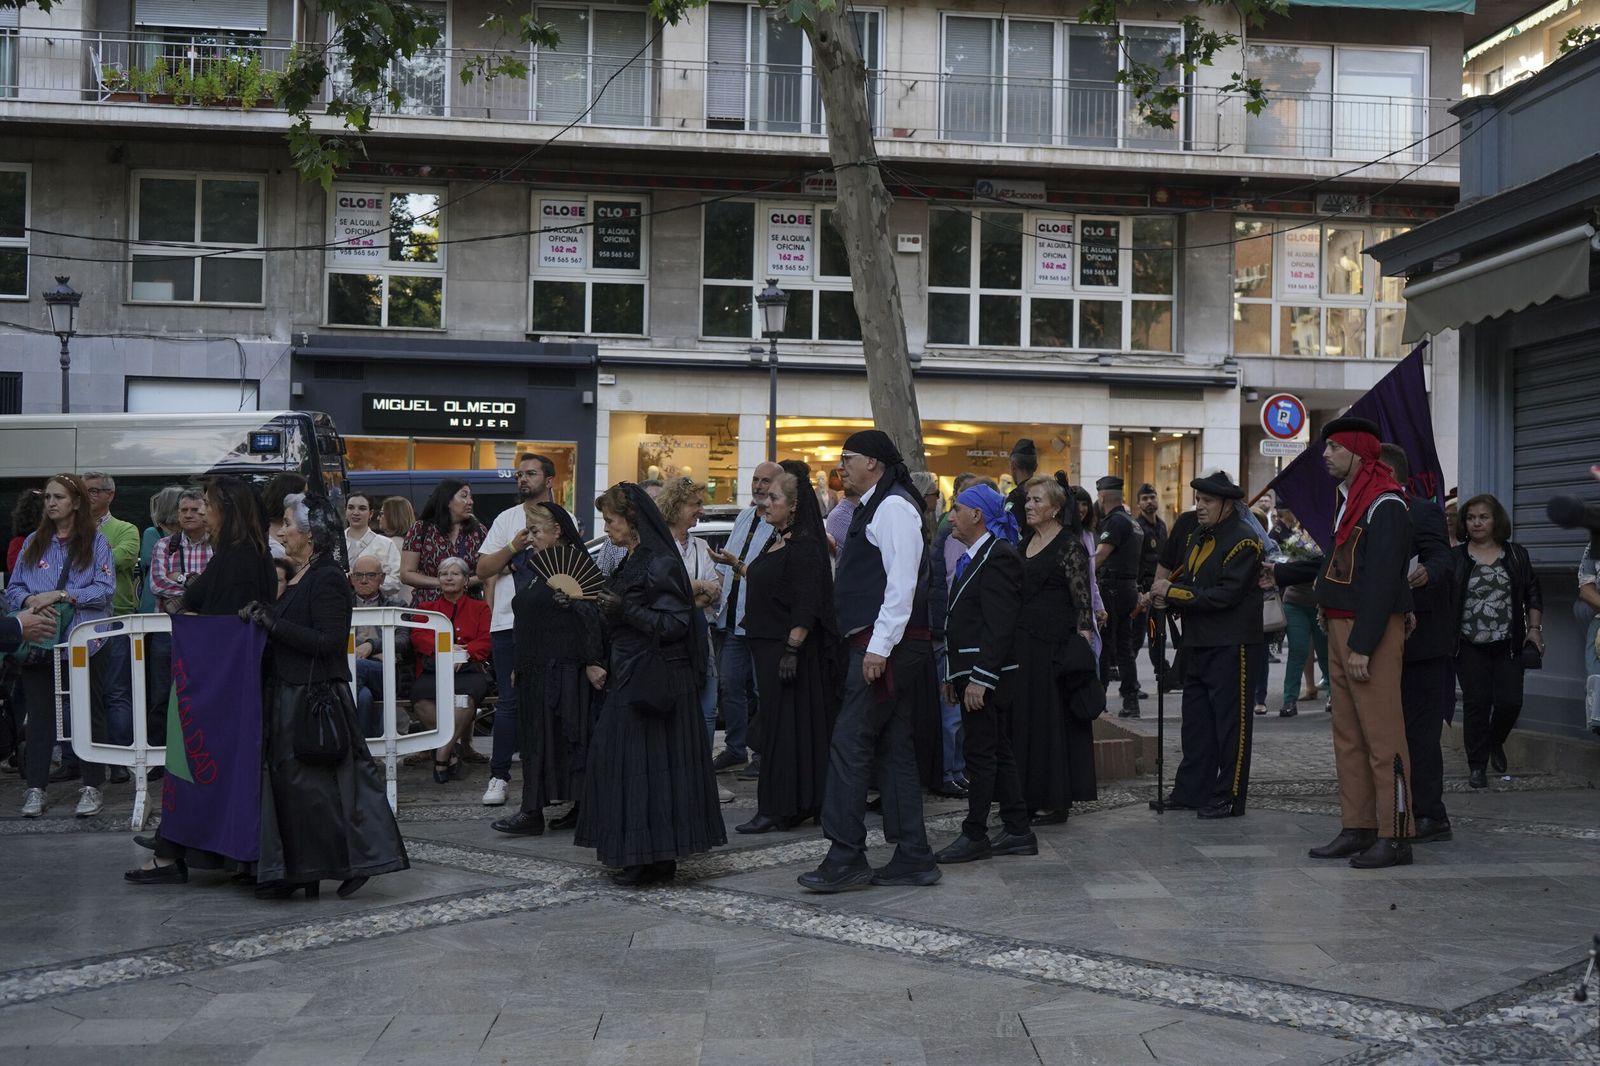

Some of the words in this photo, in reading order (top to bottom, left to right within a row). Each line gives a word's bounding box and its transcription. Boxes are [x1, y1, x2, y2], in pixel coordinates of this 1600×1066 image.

[339, 198, 382, 209] GLOBE
[543, 206, 585, 216] GLOBE
[598, 208, 637, 218] GLOBE
[771, 214, 812, 225] GLOBE
[1038, 224, 1072, 233] GLOBE
[1083, 227, 1116, 237] GLOBE
[373, 398, 438, 411] MIGUEL
[444, 401, 516, 414] OLMEDO
[1280, 412, 1287, 420] P
[450, 418, 509, 428] MUJER
